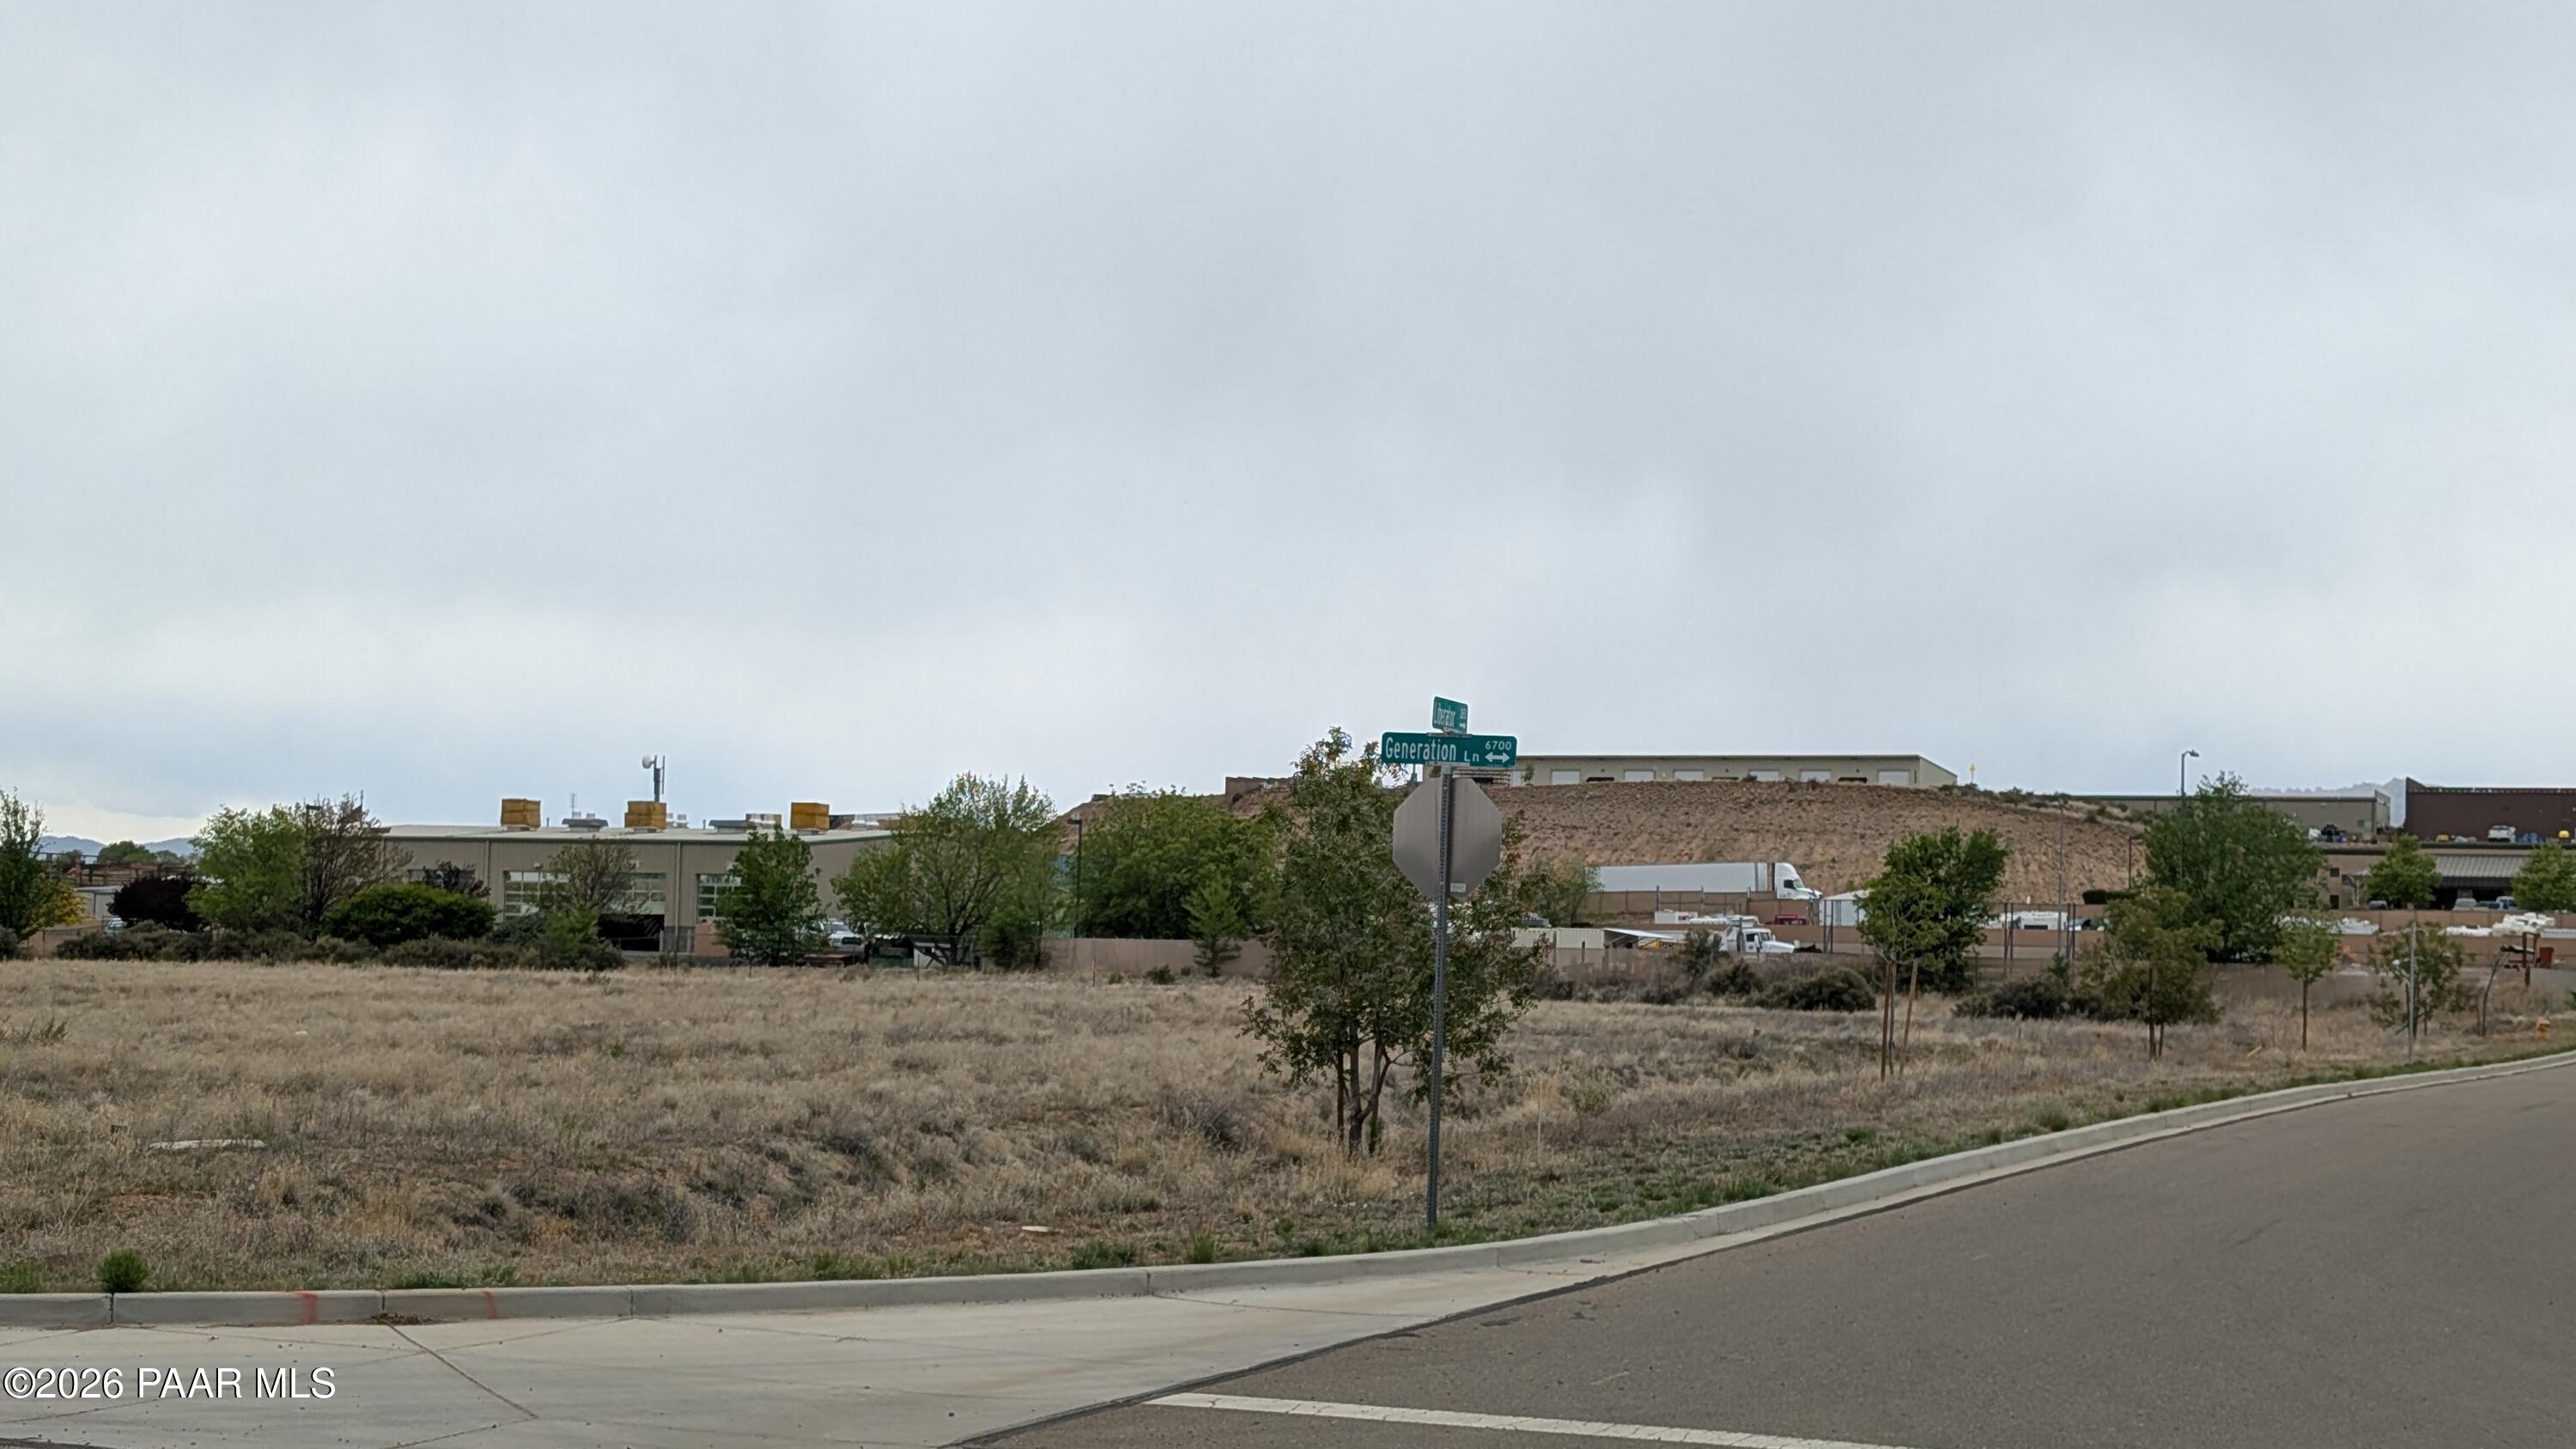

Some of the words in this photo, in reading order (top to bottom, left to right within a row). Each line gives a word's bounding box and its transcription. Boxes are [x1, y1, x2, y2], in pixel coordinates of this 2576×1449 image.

[1385, 737, 1456, 762] Generation
[1464, 751, 1479, 762] Ln
[1485, 740, 1511, 751] 6700
